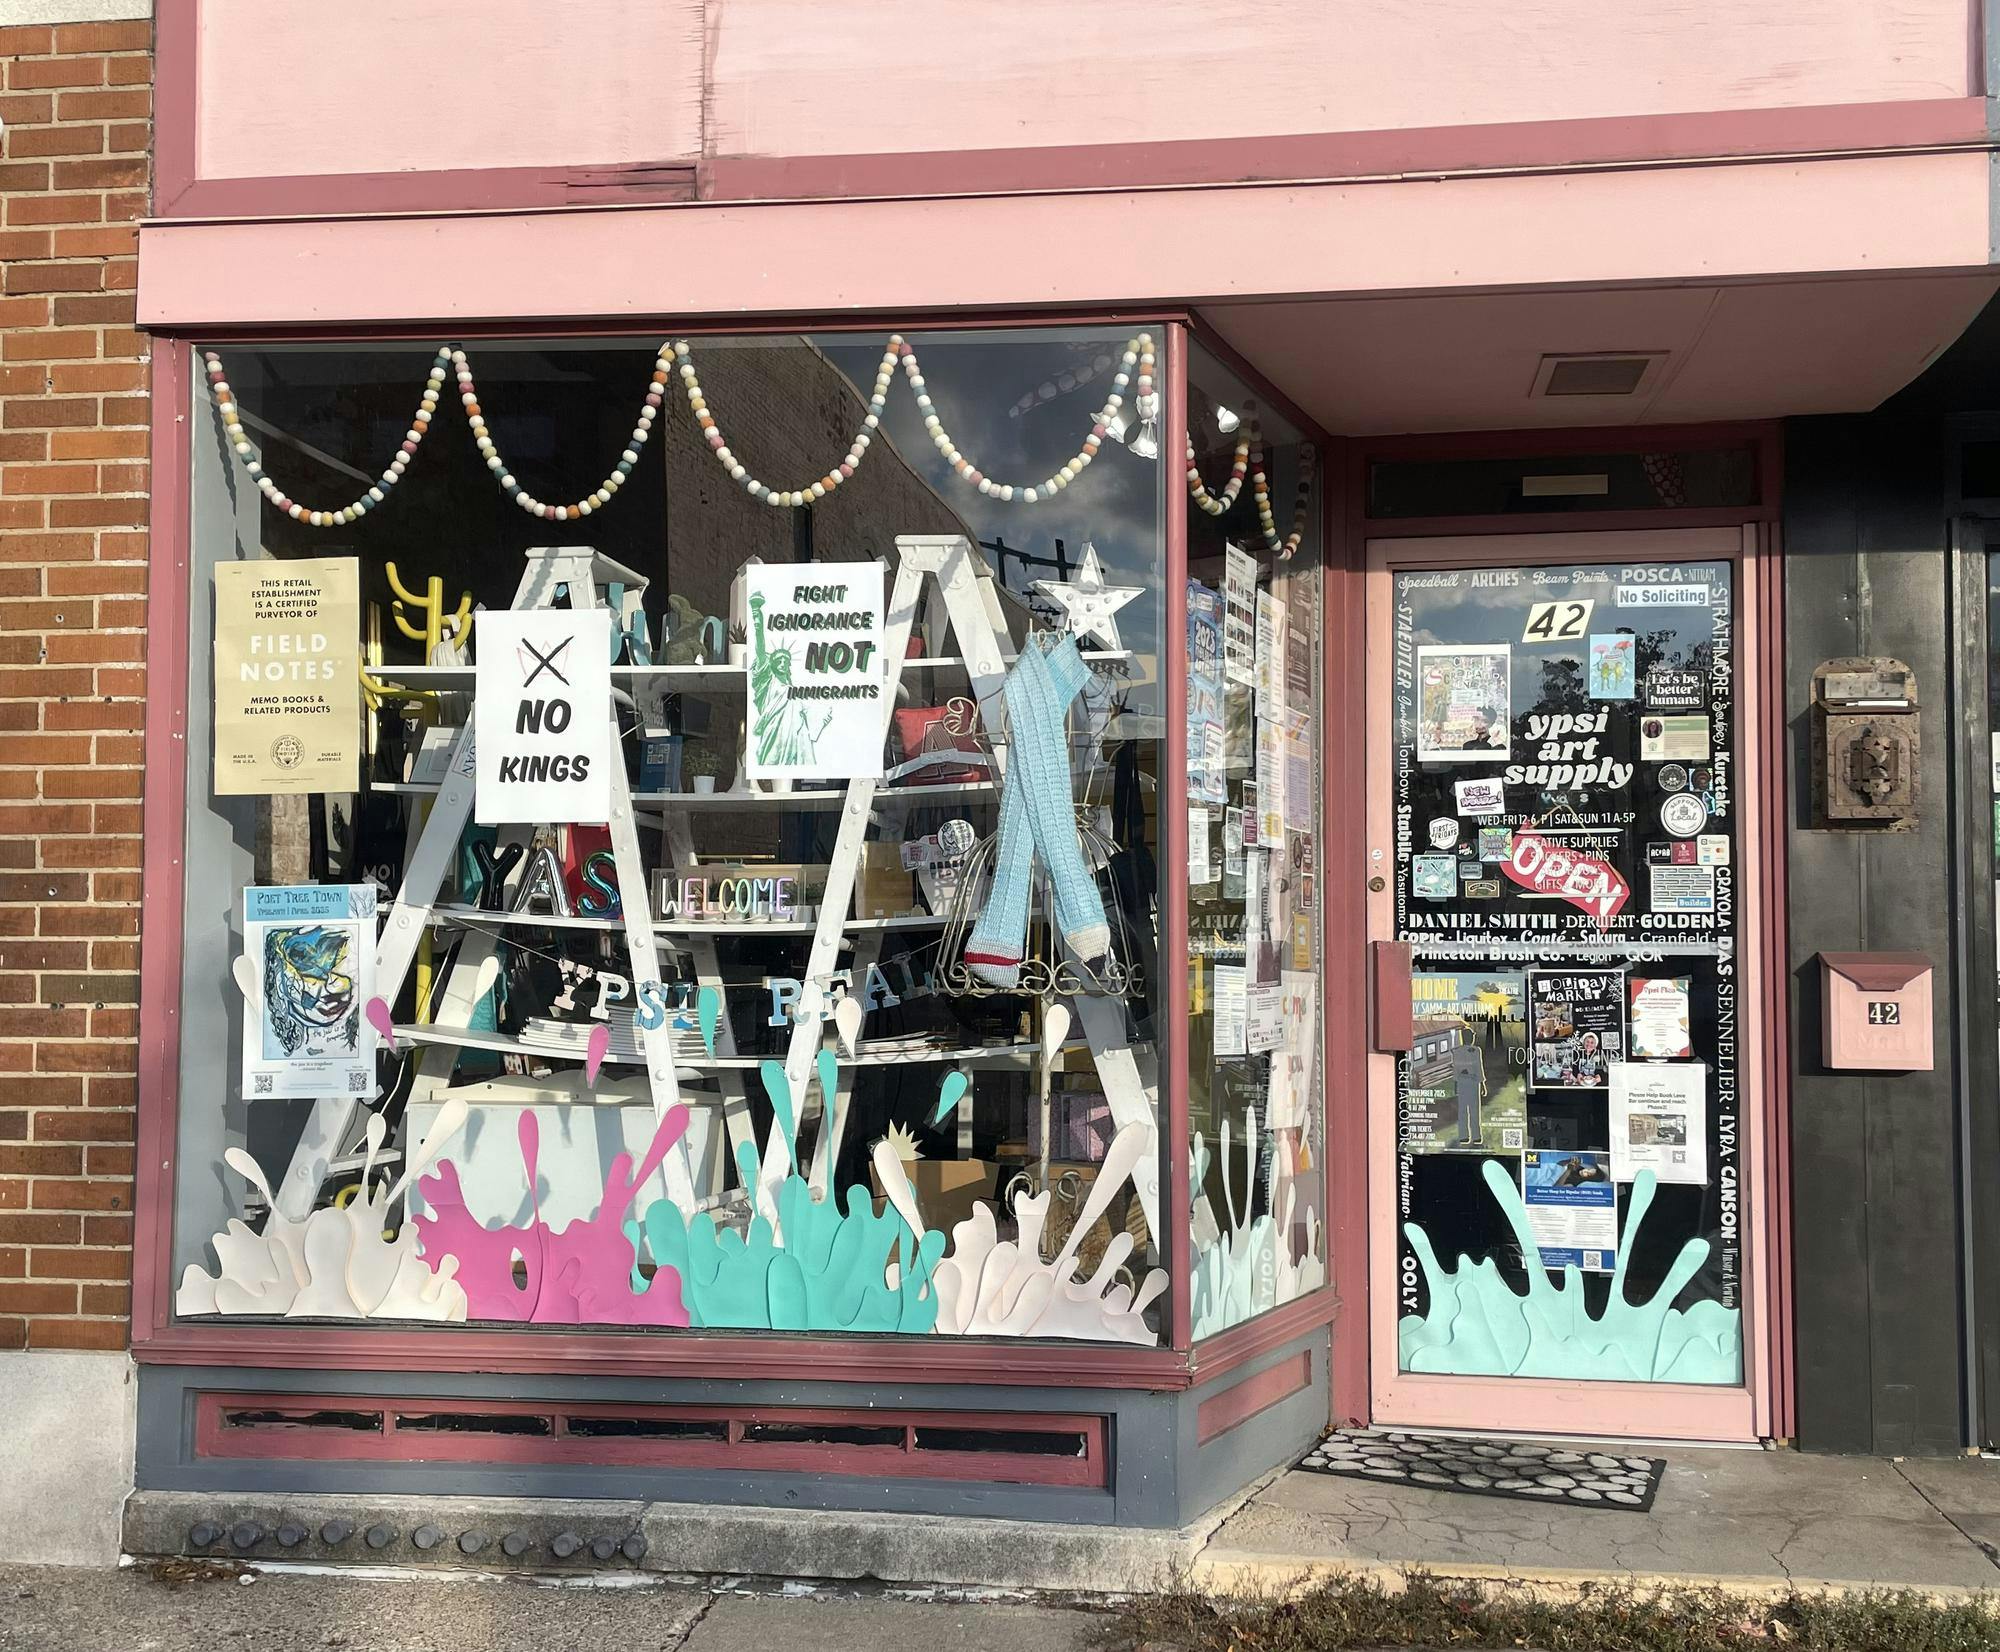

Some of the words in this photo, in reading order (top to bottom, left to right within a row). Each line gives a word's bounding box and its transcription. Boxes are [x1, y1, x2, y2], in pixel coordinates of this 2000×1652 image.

[284, 579, 312, 587] RETAIL
[1472, 572, 1519, 588] ARCHES
[1533, 571, 1570, 585] Beam
[1573, 570, 1608, 584] Paints
[1622, 568, 1683, 582] POSCA
[1689, 568, 1716, 582] NITRAM
[251, 589, 322, 598] ESTABLISHMENT
[1399, 574, 1458, 597] Speedball
[794, 585, 848, 604] FIGHT
[1620, 591, 1638, 603] No
[1642, 590, 1706, 604] Soliciting
[276, 600, 317, 608] CERTIFIED
[306, 610, 318, 618] OF
[768, 612, 874, 632] IGNORANCE
[1528, 604, 1586, 638] 42
[251, 634, 327, 654] FIELD
[1397, 604, 1412, 688] STAEDTLER
[1712, 588, 1728, 696] STRATHMORE
[805, 641, 876, 674] NOT
[240, 660, 334, 682] NOTES
[1650, 673, 1680, 684] Let's
[1683, 674, 1698, 684] be
[787, 685, 878, 700] IMMIGRANTS
[1656, 684, 1694, 694] better
[1650, 695, 1700, 705] humans
[285, 706, 330, 714] PRODUCTS
[516, 699, 572, 734] NO
[1524, 706, 1609, 740] ypsi
[1538, 737, 1600, 761] art
[499, 756, 590, 784] KINGS
[1400, 743, 1414, 799] Tombow
[1503, 756, 1634, 790] supply
[1464, 786, 1490, 796] NEW
[1714, 752, 1730, 817] Kuretake
[1555, 813, 1598, 824] SAT&SUN
[1602, 813, 1610, 822] 11
[1398, 804, 1412, 862] Stabilo
[1432, 823, 1448, 837] FIRST
[1434, 829, 1457, 842] FRIDAYS
[1571, 836, 1618, 848] SUPPLIES
[1530, 851, 1578, 861] SICKERS
[1586, 850, 1610, 861] PINS
[1513, 838, 1622, 918] OPEN
[1535, 879, 1562, 890] GIFTS
[258, 893, 281, 904] POET
[284, 892, 309, 903] TREE
[313, 891, 342, 902] TOWN
[661, 877, 794, 916] WELCOME
[1398, 867, 1408, 924] Yasutomo
[1716, 866, 1732, 928] CRAYOLA
[1410, 914, 1486, 928] DANIEL
[1489, 914, 1557, 928] SMITH
[1566, 915, 1635, 928] DERWENT
[1641, 914, 1714, 928] GOLDEN
[1398, 931, 1444, 944] COPIC
[1456, 930, 1508, 948] Liquitex
[1520, 930, 1566, 944] Conté
[1580, 930, 1626, 944] Sakura
[1640, 932, 1710, 944] Cranfield
[1412, 946, 1484, 960] Princeton
[1490, 946, 1534, 960] Brush
[1538, 947, 1565, 961] Co.
[1576, 951, 1612, 964] Legion
[1626, 949, 1664, 962] QOR
[1718, 937, 1733, 976] DAS
[1412, 978, 1458, 1000] HOME
[1870, 1003, 1898, 1024] 42
[1718, 984, 1734, 1102] SENNELIER
[1508, 1047, 1535, 1064] FOR
[1398, 1057, 1410, 1147] CRETACOLOR
[1720, 1114, 1736, 1156] LYRA
[1402, 1154, 1414, 1212] Fabriano
[1720, 1166, 1736, 1239] CANSON
[1402, 1257, 1418, 1308] OOLY
